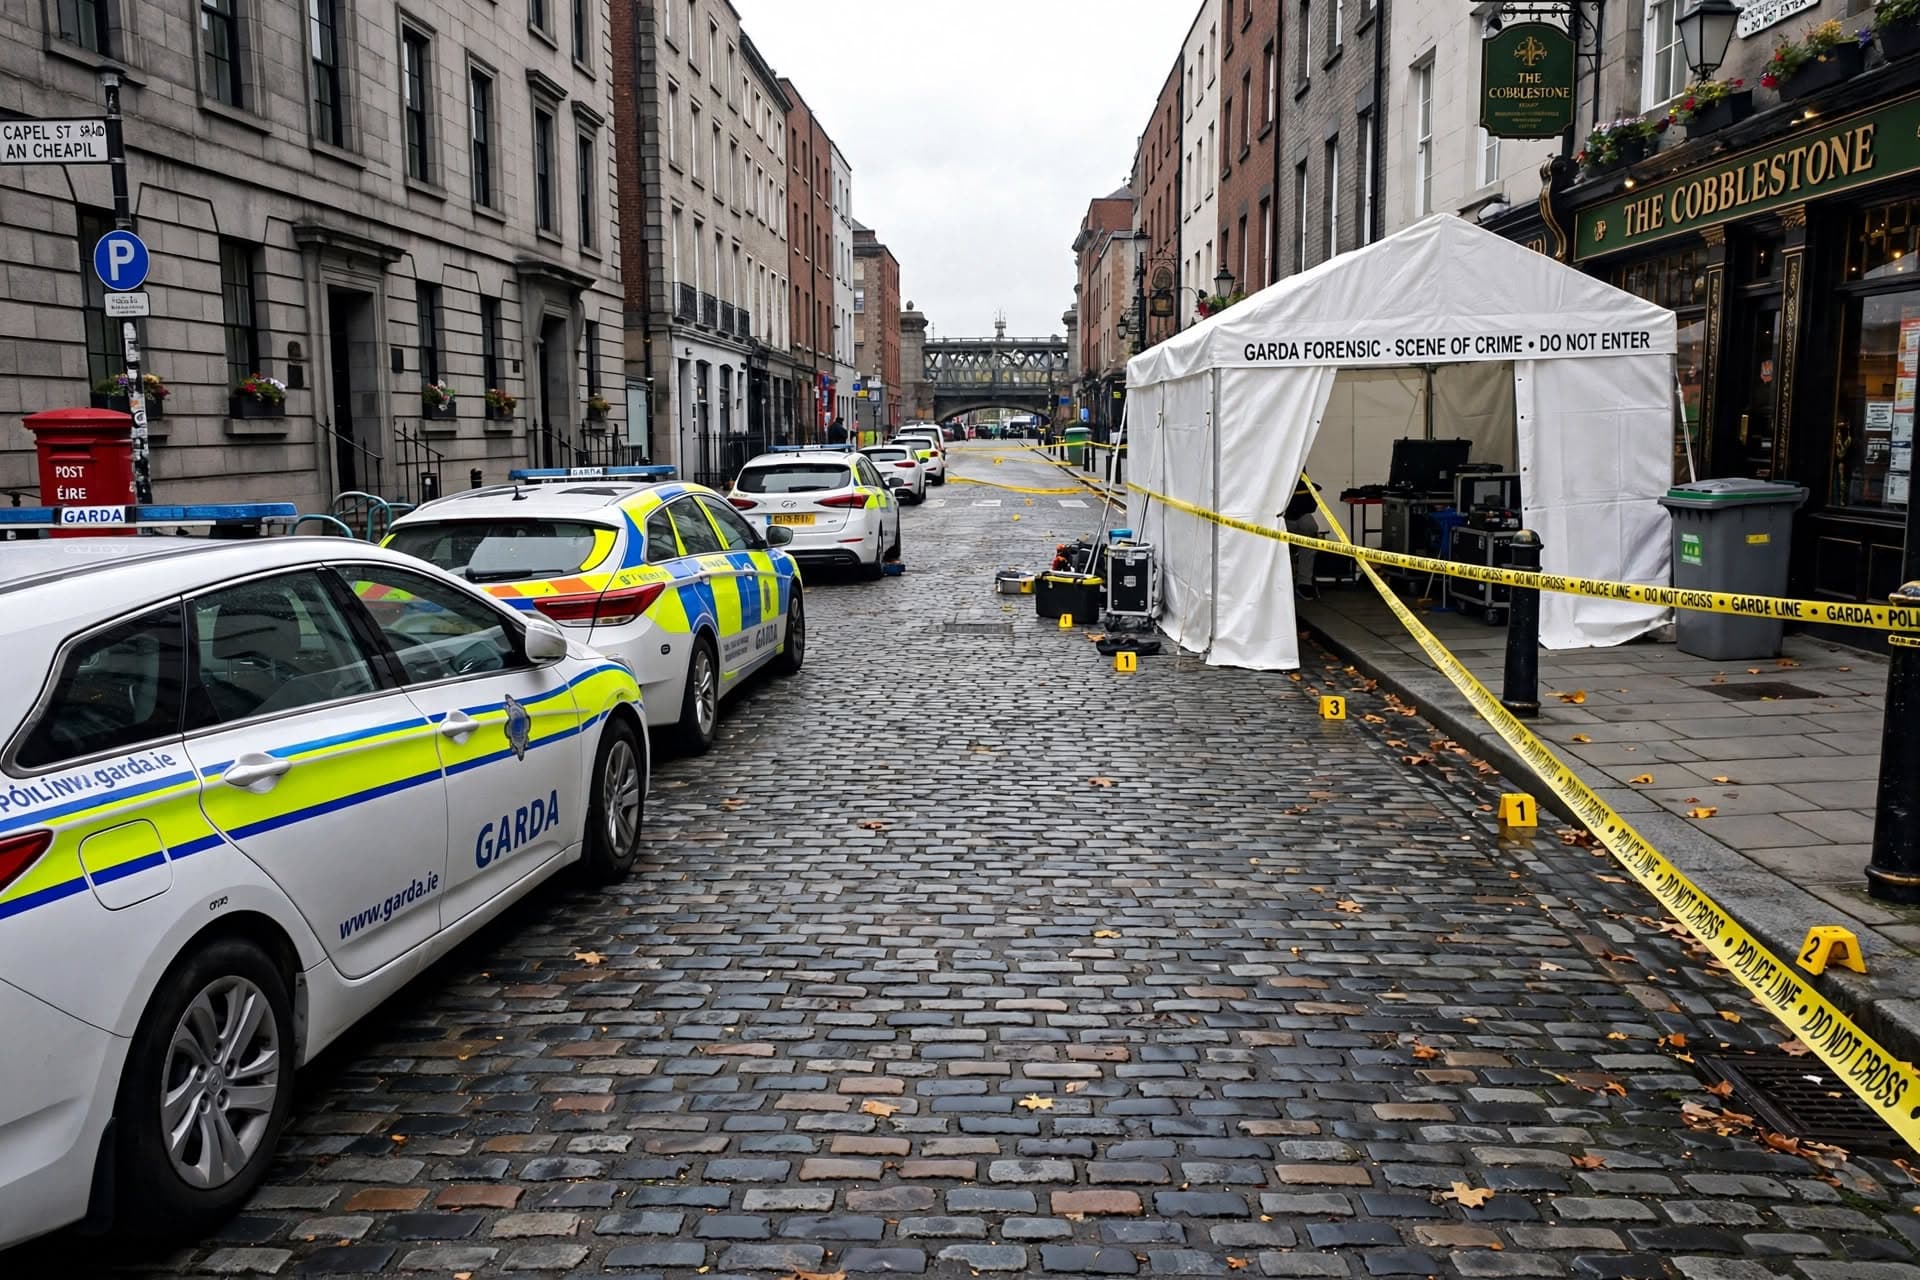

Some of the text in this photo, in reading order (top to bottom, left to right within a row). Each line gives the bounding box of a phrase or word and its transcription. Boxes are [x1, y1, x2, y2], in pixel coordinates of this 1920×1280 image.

[1518, 72, 1542, 83] THE
[1488, 87, 1570, 98] COBBLESTONE
[3, 125, 50, 140] CAPEL
[56, 125, 71, 138] ST
[7, 143, 97, 158] AN CHEAPIL
[1624, 123, 1875, 237] THE COBBLESTONE
[108, 240, 135, 281] P
[1244, 331, 1650, 360] GARDA FORENSIC SCENE OF CRIME DO NOT ENTER
[56, 466, 84, 478] POST
[57, 485, 87, 499] ÉIRE
[64, 509, 124, 523] GARDA
[1526, 574, 1539, 587] NOT
[1541, 576, 1565, 590] CROSS
[1580, 580, 1609, 596] POLICE
[1612, 584, 1631, 599] LINE
[1644, 587, 1657, 602] DO
[1660, 589, 1679, 605] NOT
[1681, 592, 1712, 608] CROSS
[1775, 600, 1802, 617] LINE
[1827, 606, 1873, 624] GARDA
[1124, 656, 1129, 668] 1
[1330, 700, 1340, 715] 3
[1516, 800, 1525, 821] 1
[476, 789, 559, 868] GARDA
[340, 871, 438, 940] www.garda.ie
[1803, 936, 1820, 963] 2
[1609, 828, 1644, 862] POLICE
[1634, 850, 1660, 878] LINE
[1656, 873, 1679, 897] DO
[1669, 884, 1697, 912] NOT
[1687, 901, 1725, 939] CROSS
[1728, 939, 1776, 988] POLICE
[1764, 973, 1802, 1010] LINE
[1800, 1005, 1833, 1039] DO
[1820, 1022, 1862, 1064] NOT
[1849, 1048, 1908, 1108] CROSS
